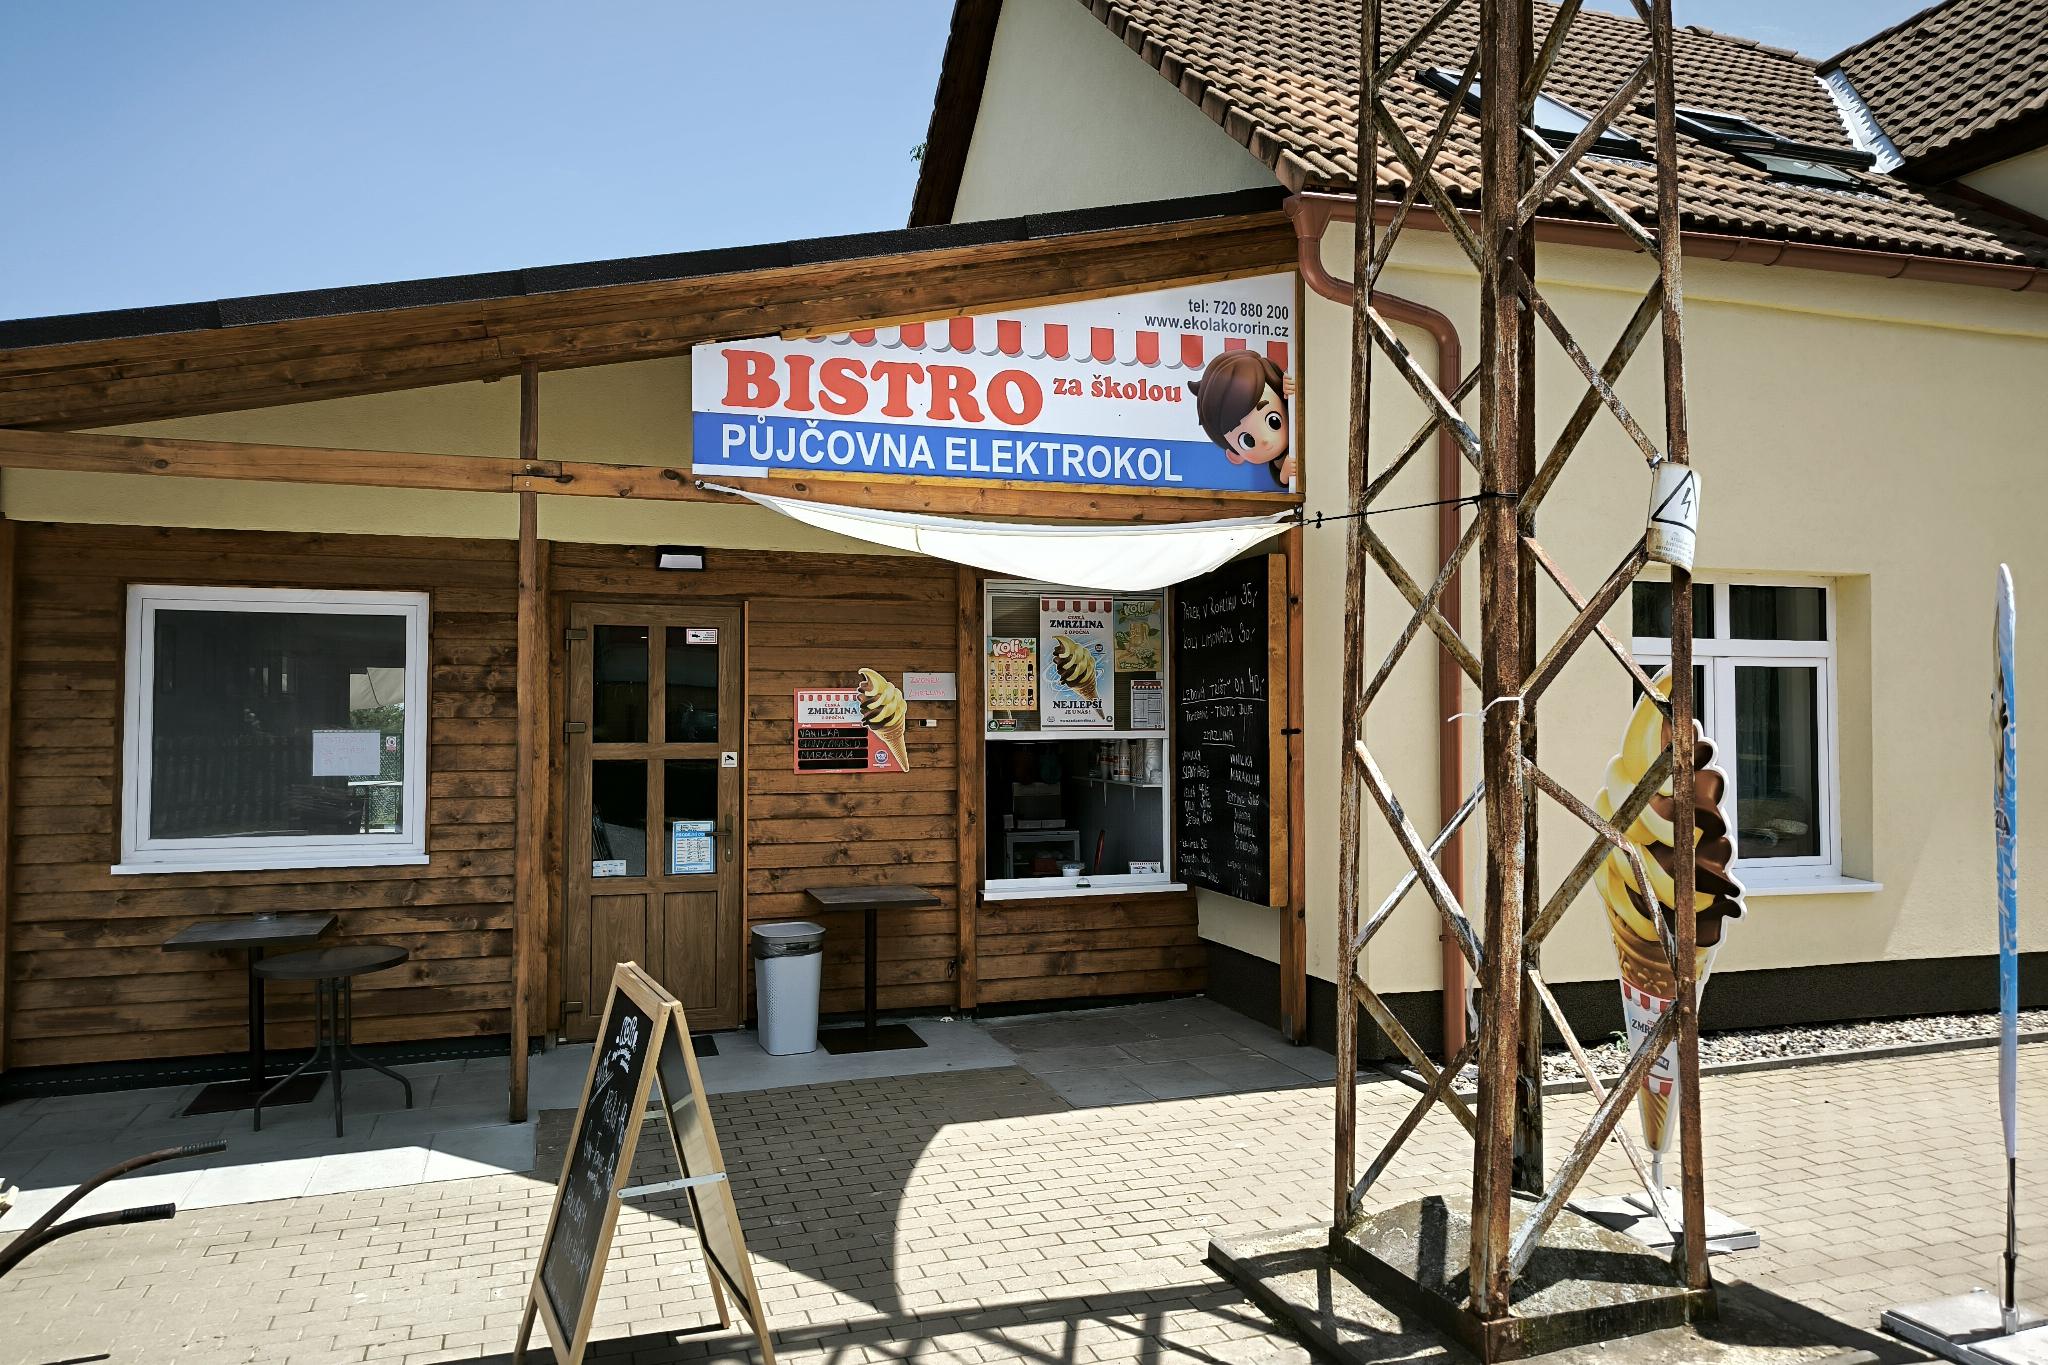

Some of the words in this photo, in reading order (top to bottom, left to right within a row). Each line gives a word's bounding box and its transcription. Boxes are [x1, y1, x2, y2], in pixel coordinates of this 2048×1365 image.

[1188, 298, 1209, 314] tel:
[1213, 300, 1236, 316] 720
[1240, 302, 1263, 318] 880
[1266, 304, 1289, 320] 200
[1145, 315, 1289, 338] www.ekolakororin.cz
[721, 348, 1043, 426] BISTRO
[1053, 376, 1083, 397] za
[1091, 374, 1182, 403] školou
[722, 414, 936, 471] PŮJČOVNA
[945, 436, 1183, 483] ELEKTROKOL
[1049, 620, 1104, 629] ZMRZLINA
[807, 707, 858, 715] ZMRZLINA
[1052, 699, 1102, 709] NEJLEPŠÍ
[800, 729, 840, 738] VANILKA
